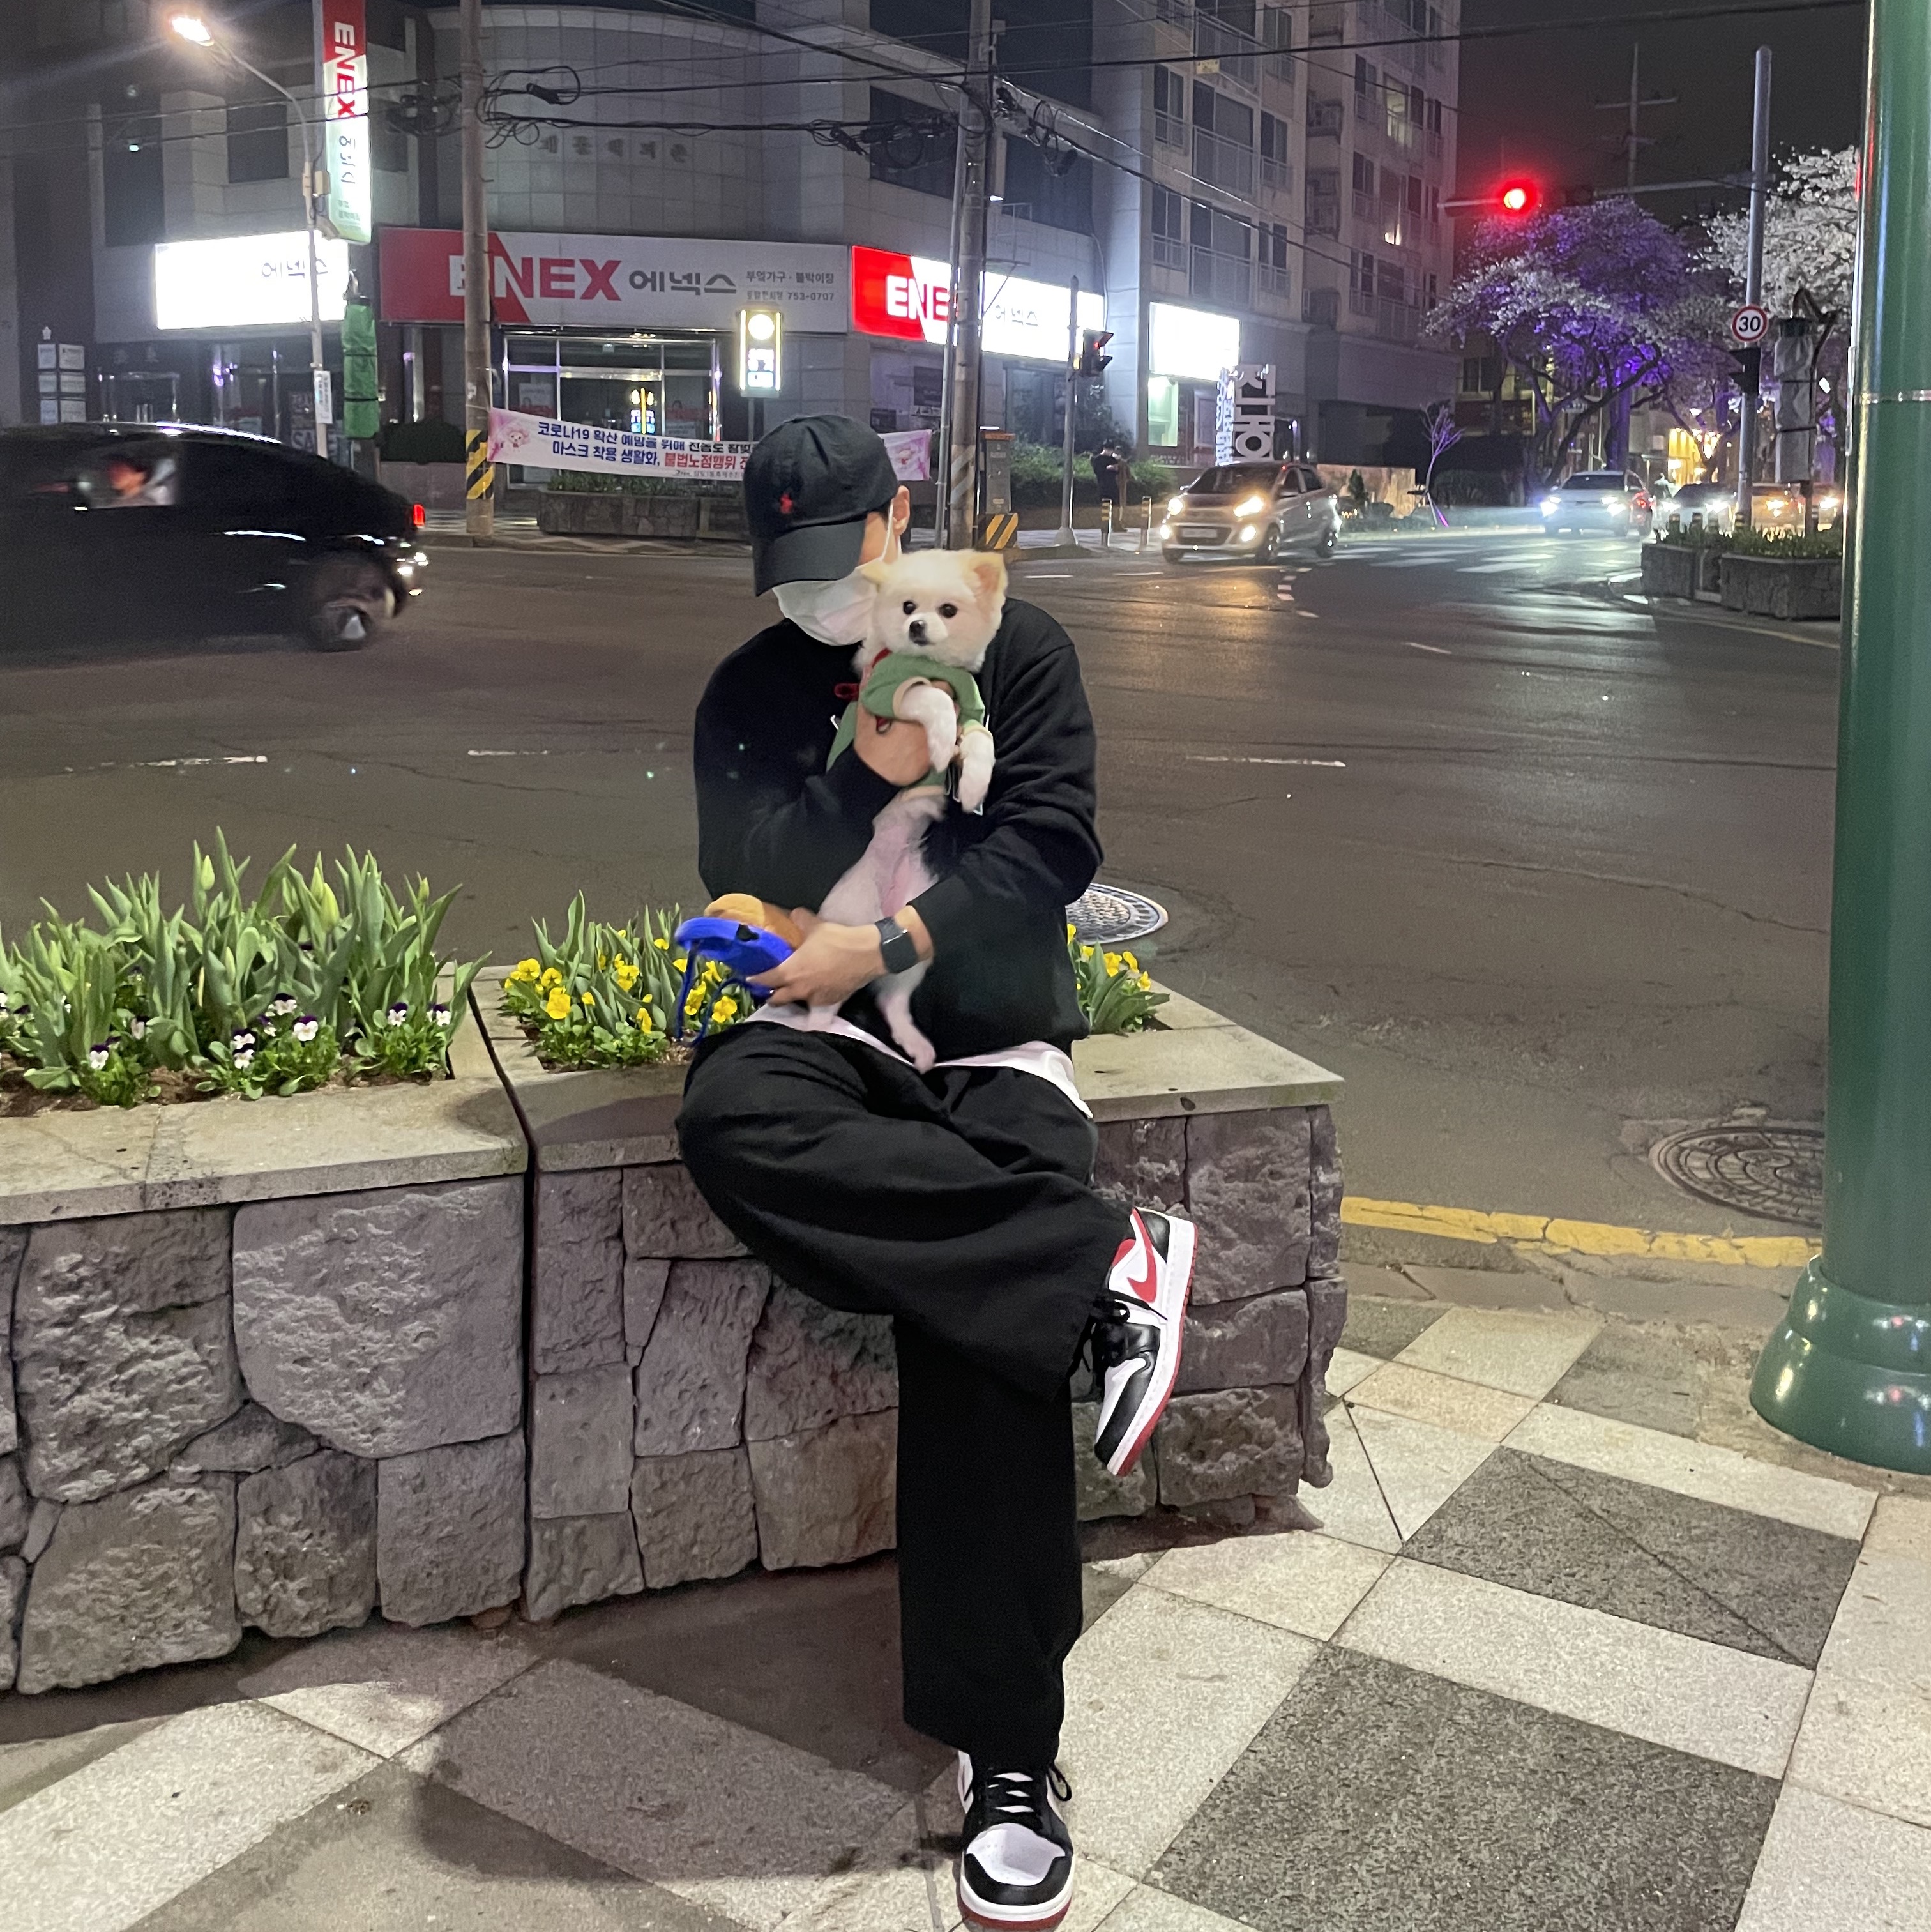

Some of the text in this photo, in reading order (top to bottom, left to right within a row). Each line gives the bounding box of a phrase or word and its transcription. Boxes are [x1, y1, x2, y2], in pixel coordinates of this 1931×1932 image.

[333, 21, 356, 119] ENEX
[628, 270, 737, 296] 에넥스
[787, 291, 835, 301] 753-0707
[886, 275, 950, 323] ENE
[1738, 316, 1761, 332] 30
[292, 429, 338, 455] SAE
[538, 422, 590, 440] 코로나19
[593, 430, 618, 445] 확산
[661, 439, 685, 452] 위해
[552, 441, 589, 458] 마스크
[593, 446, 617, 462] 착용
[621, 448, 660, 467] 생활화,
[665, 452, 736, 471] 불법노점행위
